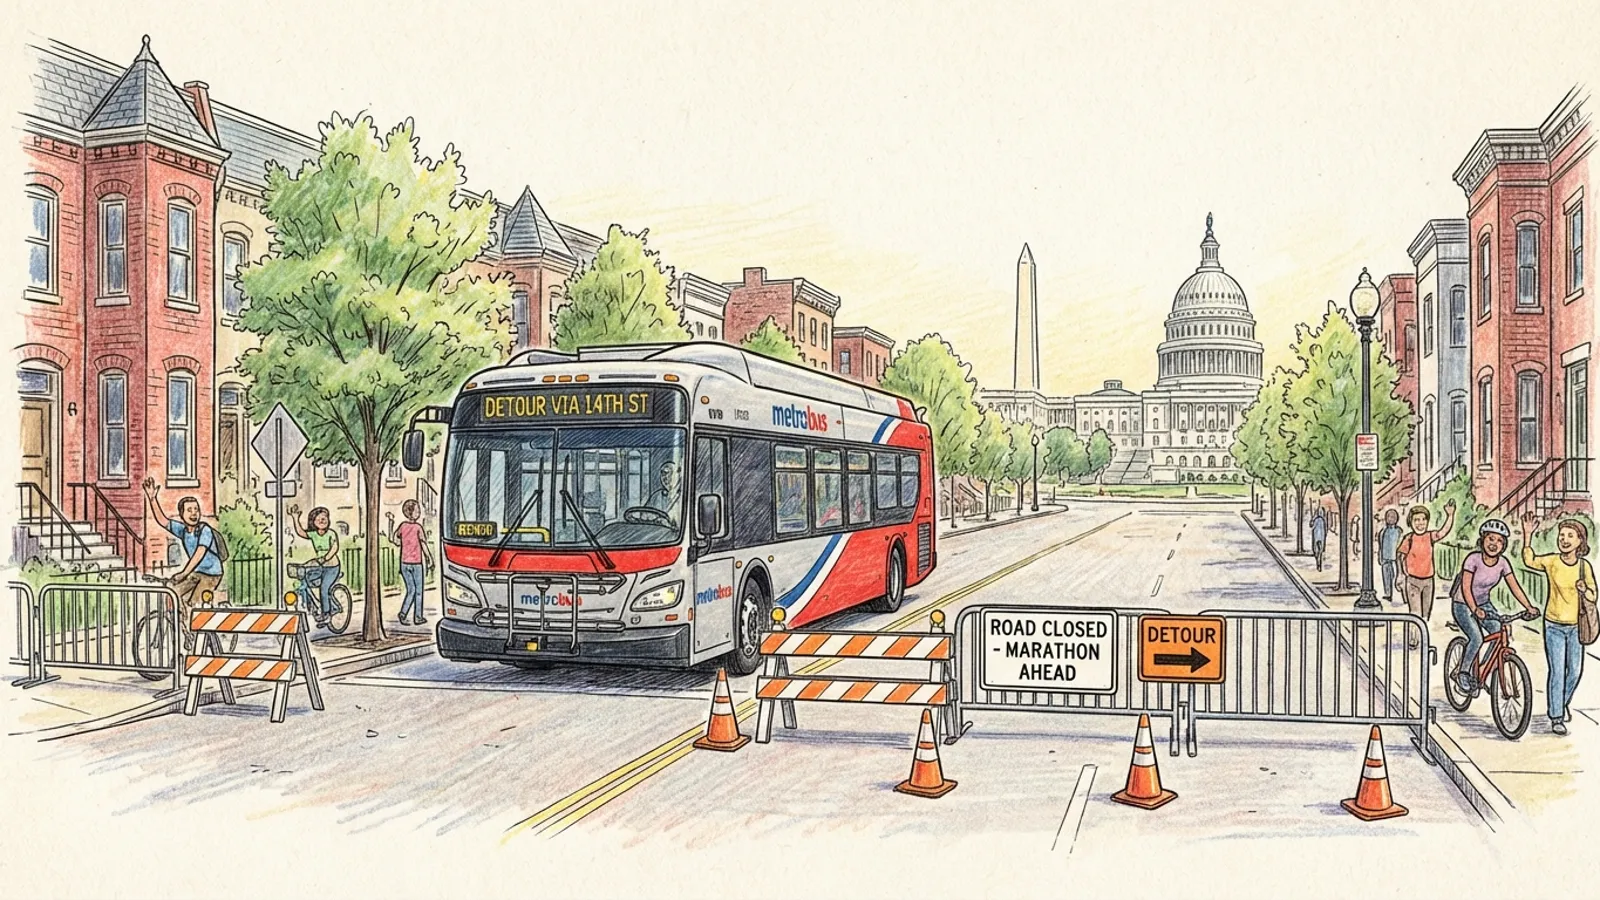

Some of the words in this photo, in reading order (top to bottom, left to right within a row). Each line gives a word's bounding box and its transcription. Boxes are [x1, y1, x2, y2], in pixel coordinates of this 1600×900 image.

[484, 395, 546, 418] DETOUR
[551, 394, 580, 415] VIA
[585, 394, 623, 414] 14TH
[628, 393, 648, 413] ST
[772, 403, 828, 432] metrobus
[990, 619, 1036, 636] ROAD
[1042, 620, 1107, 638] CLOSED
[1147, 626, 1216, 643] DETOUR
[1005, 642, 1100, 660] MARATHON
[1018, 664, 1077, 681] AHEAD
